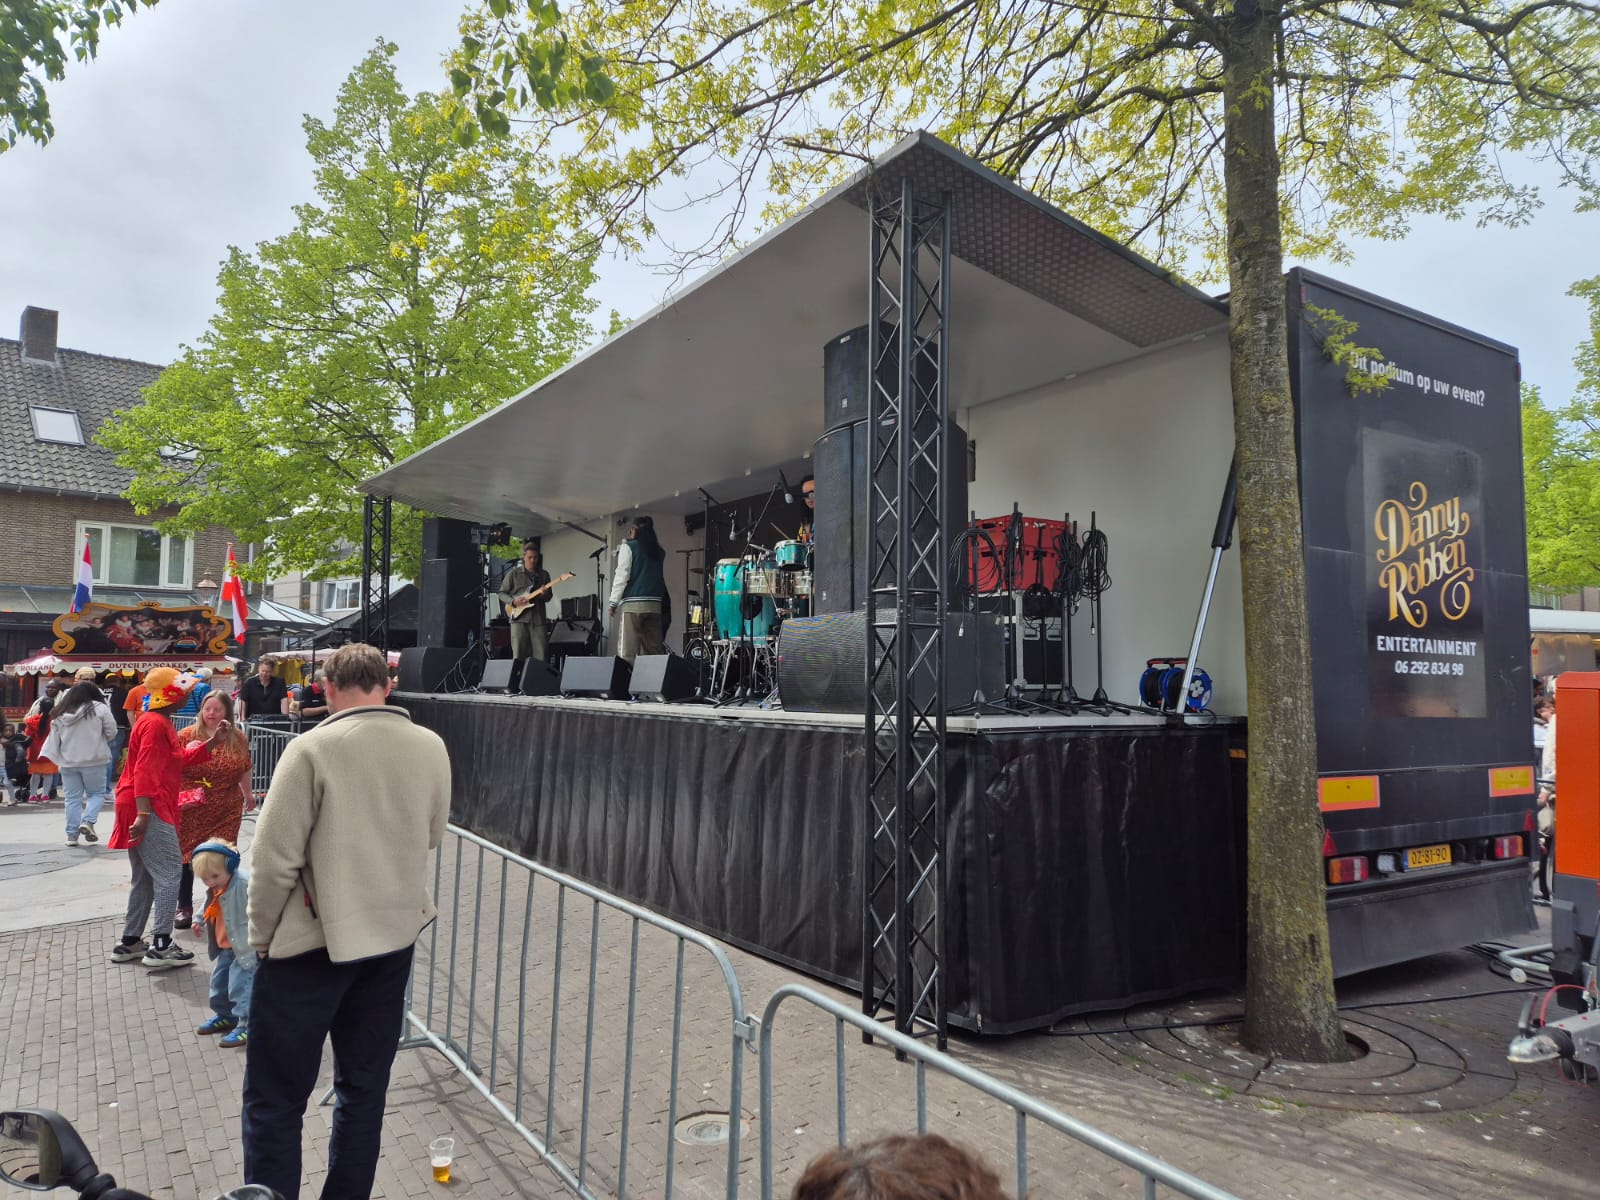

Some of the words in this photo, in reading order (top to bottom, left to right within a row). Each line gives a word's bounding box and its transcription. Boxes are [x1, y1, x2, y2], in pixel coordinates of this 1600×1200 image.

[1370, 360, 1414, 386] podium
[1416, 374, 1431, 394] op
[1433, 379, 1450, 396] uw
[1452, 385, 1486, 407] event?
[1375, 481, 1471, 563] Danny
[1379, 538, 1474, 628] Robben
[1376, 635, 1477, 657] ENTERTAINMENT
[20, 664, 55, 672] HOLLAND
[1394, 660, 1408, 675] 06
[1410, 661, 1430, 675] 292
[1431, 661, 1450, 675] 834
[1451, 662, 1464, 676] 98
